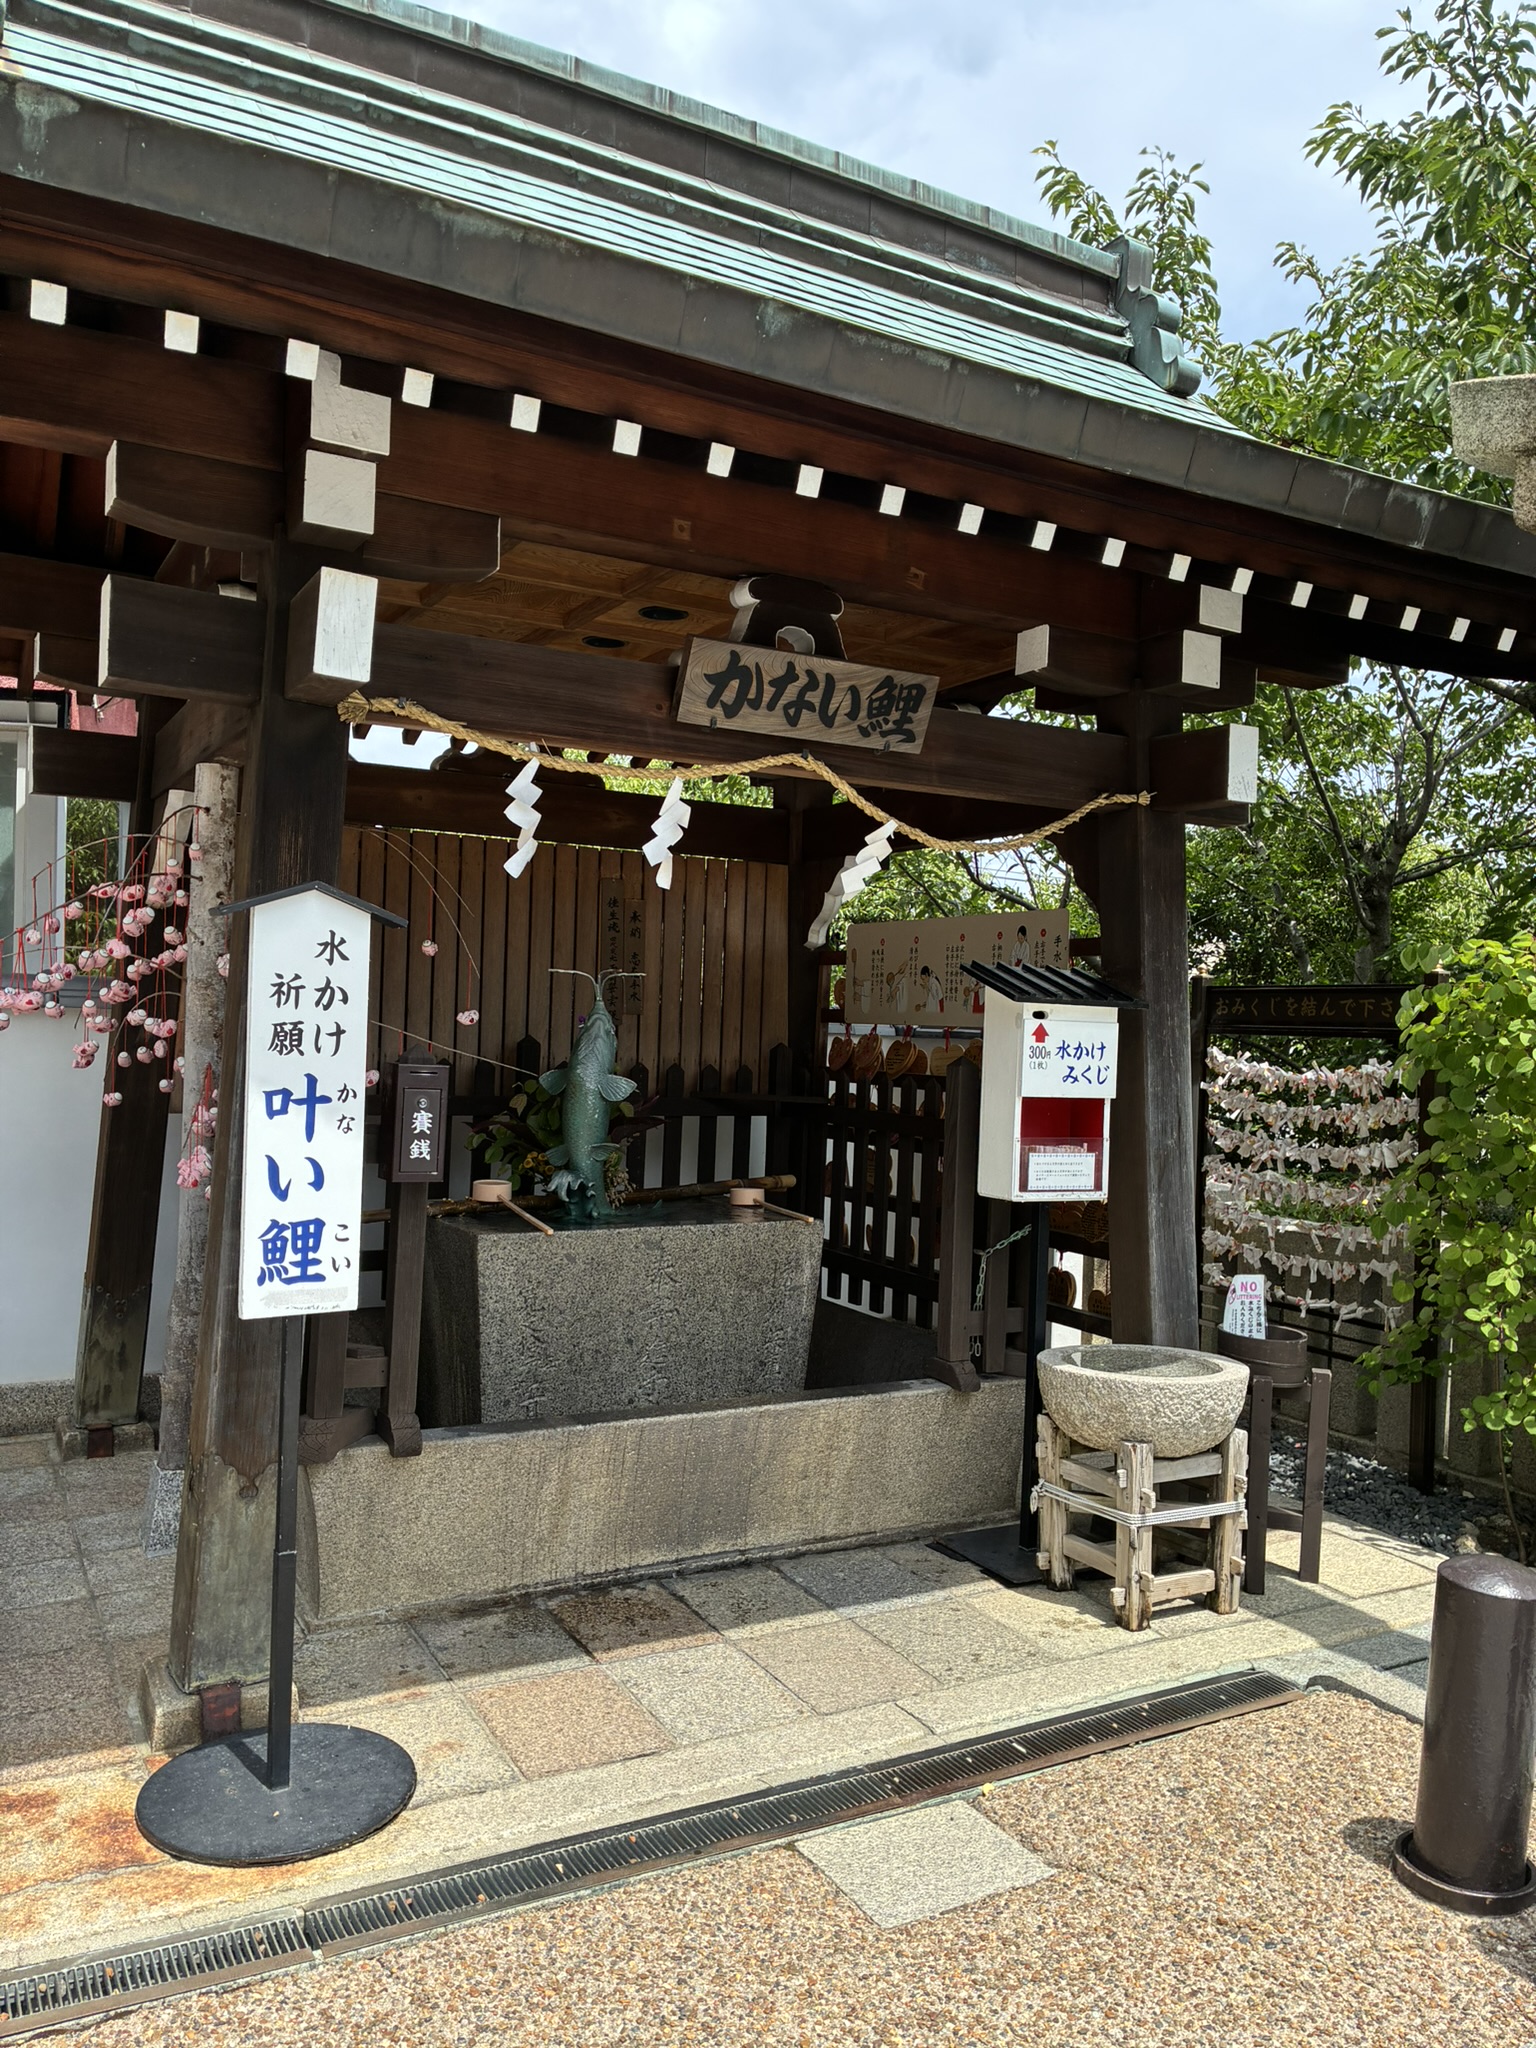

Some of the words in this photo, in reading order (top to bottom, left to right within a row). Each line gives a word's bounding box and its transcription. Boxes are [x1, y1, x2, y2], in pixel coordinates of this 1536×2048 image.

[704, 650, 927, 743] かない鯉
[1053, 934, 1062, 969] 手水
[268, 973, 306, 1057] 祈願
[313, 930, 350, 1057] 水かけ
[1029, 1045, 1051, 1060] 300円
[1054, 1039, 1107, 1062] 水かけ
[1062, 1065, 1110, 1085] みくじ
[336, 1083, 357, 1134] かな
[409, 1110, 433, 1160] 賽銭
[257, 1072, 332, 1287] 叶い鯉
[331, 1223, 351, 1273] こい
[1240, 1281, 1257, 1292] NO
